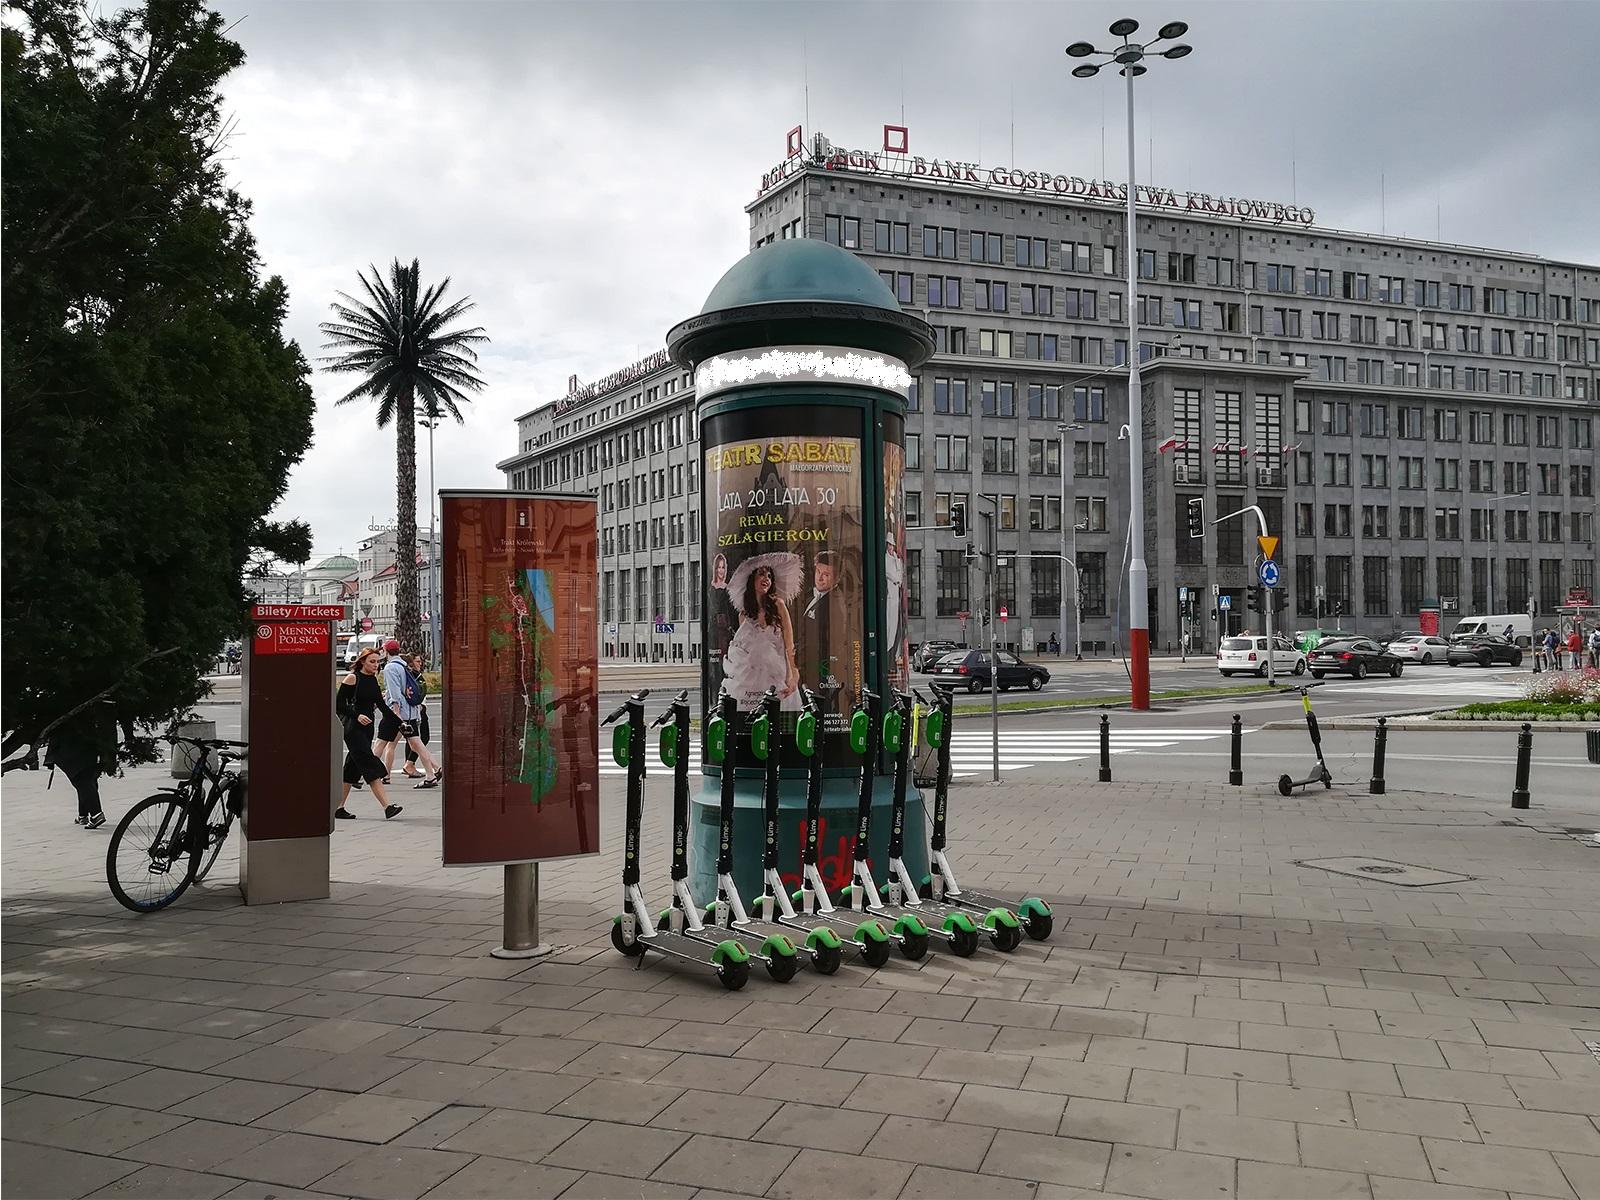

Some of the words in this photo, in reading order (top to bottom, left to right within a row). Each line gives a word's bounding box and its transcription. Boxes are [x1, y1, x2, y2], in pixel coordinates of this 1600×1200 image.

[761, 160, 787, 191] BGK
[836, 147, 880, 171] BGK
[913, 156, 980, 182] BANK
[991, 166, 1179, 208] GOSPODARSTWA
[1186, 191, 1316, 224] KRAJOWEGO
[706, 444, 762, 473] TEATR
[766, 441, 856, 463] SABAT
[719, 491, 743, 512] LATA
[774, 487, 811, 506] LATA
[368, 515, 399, 532] dancin
[739, 512, 785, 528] REWIA
[718, 527, 828, 547] SZLAGIERÓW
[257, 606, 292, 618] Bilety
[294, 606, 299, 617] /
[301, 606, 340, 617] Tickets
[279, 626, 328, 636] MENNICA
[279, 636, 320, 645] POLSKA
[767, 820, 775, 837] Lime
[860, 816, 868, 832] Lime
